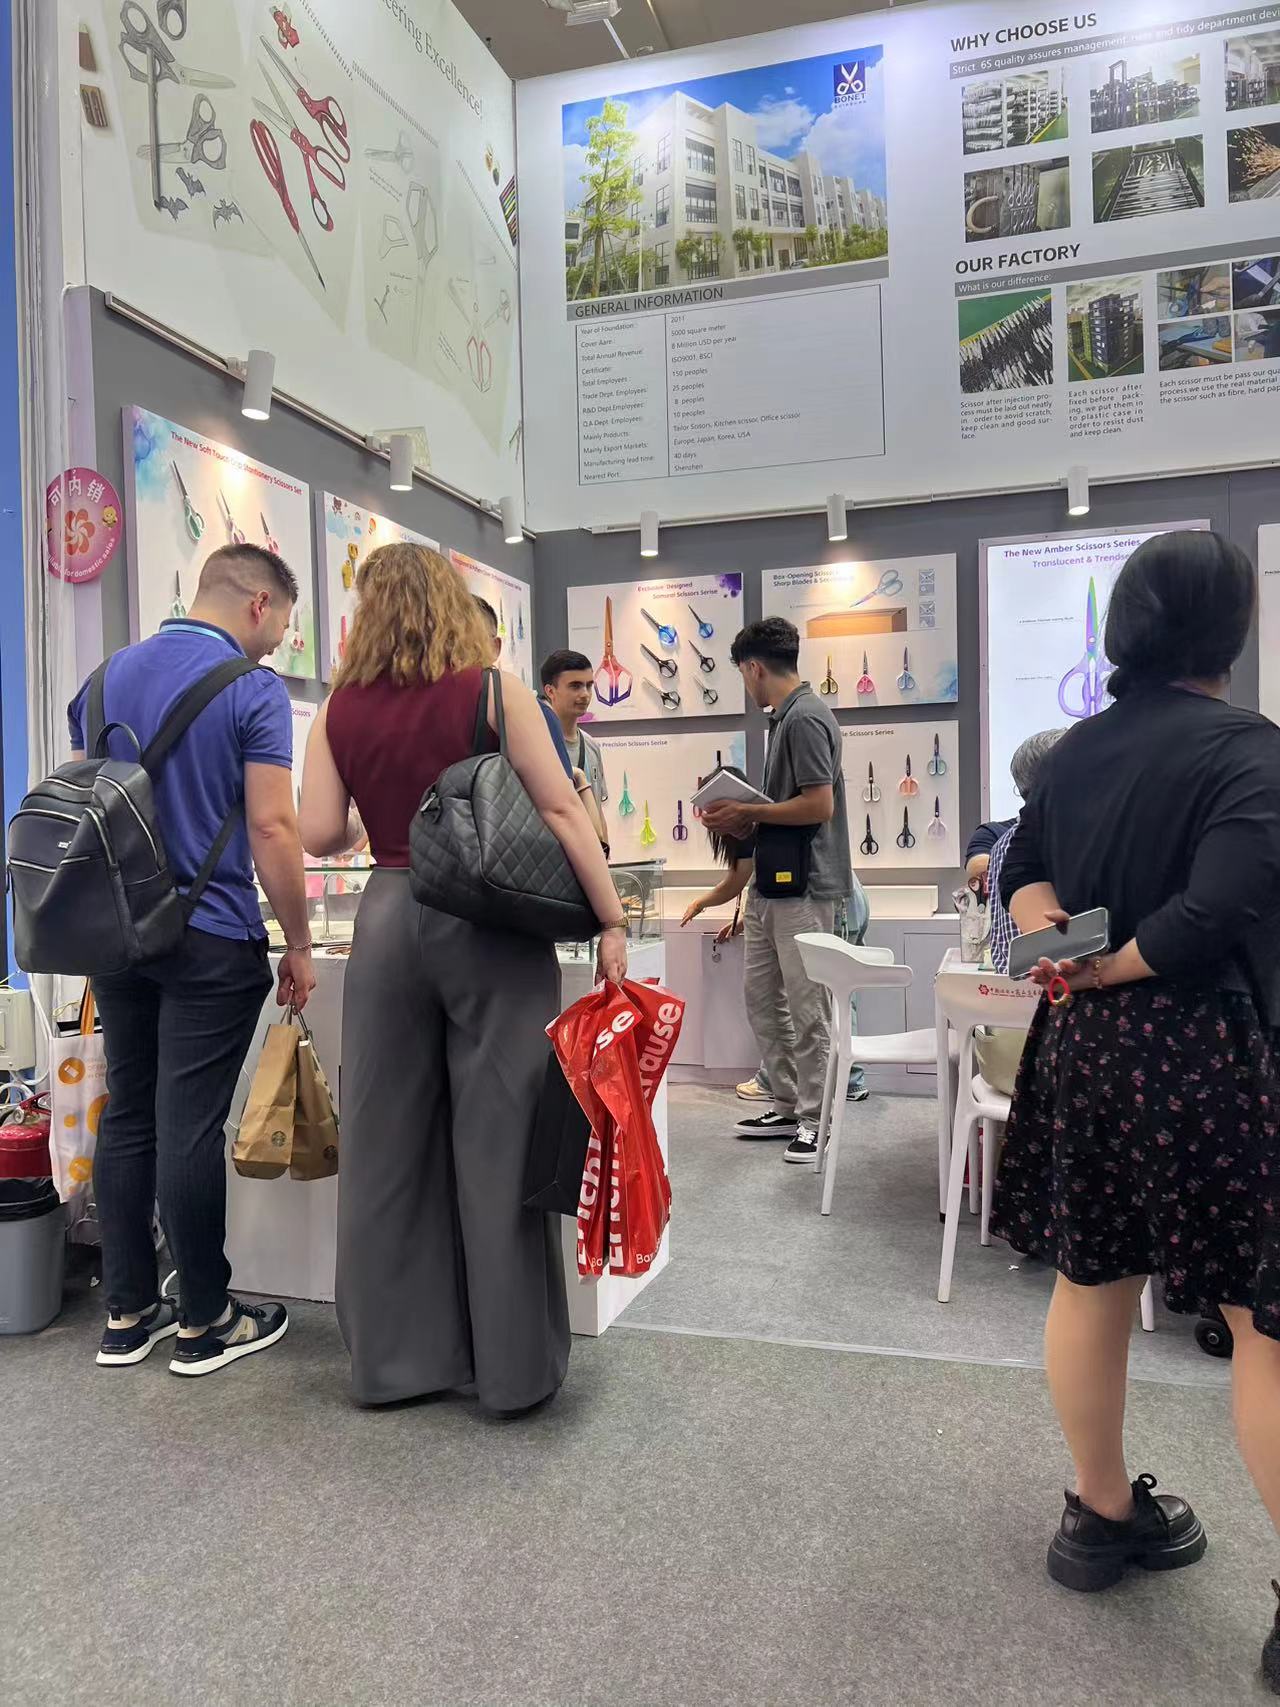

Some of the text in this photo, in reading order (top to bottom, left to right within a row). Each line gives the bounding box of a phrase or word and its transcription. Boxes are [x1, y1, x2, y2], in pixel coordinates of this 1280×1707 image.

[950, 13, 1097, 52] WHY CHOOSE US
[952, 62, 976, 75] Strict
[994, 54, 1026, 68] quality
[1027, 48, 1062, 61] assures
[1176, 23, 1196, 36] tidy
[1197, 12, 1257, 31] department
[955, 243, 1081, 275] OUR FACTORY
[958, 283, 981, 293] What
[982, 281, 990, 290] is
[991, 279, 1006, 289] our
[575, 287, 724, 318] GENERAL INFORMATION
[687, 327, 707, 336] square
[708, 324, 727, 332] meter
[698, 338, 712, 346] USD
[724, 336, 737, 344] year
[582, 354, 596, 362] Total
[596, 351, 617, 359] Annual
[699, 352, 713, 360] BSCI
[582, 379, 596, 387] Total
[1159, 380, 1177, 388] Each
[1177, 377, 1201, 385] scissor
[1203, 374, 1222, 382] must
[1234, 371, 1251, 379] pass
[1246, 377, 1278, 385] material
[582, 392, 598, 400] Trade
[1068, 384, 1143, 398] Each scissor after
[960, 394, 1035, 409] Scissor after injection
[1068, 398, 1087, 406] fixed
[1089, 395, 1115, 404] before
[1160, 396, 1172, 404] the
[1173, 394, 1198, 402] scissor
[1199, 391, 1217, 399] such
[582, 406, 597, 414] R&D
[960, 409, 975, 417] cess
[993, 405, 1003, 413] be
[1004, 404, 1017, 412] laid
[1031, 400, 1053, 410] neatly
[1098, 402, 1112, 411] put
[1113, 401, 1134, 409] them
[973, 414, 993, 423] order
[1080, 412, 1110, 421] plastic
[1112, 409, 1132, 417] case
[673, 424, 690, 432] Tailor
[713, 419, 737, 427] Kitchen
[780, 412, 801, 420] scissor
[979, 421, 999, 431] clean
[1000, 420, 1015, 428] and
[1016, 418, 1036, 428] good
[1069, 421, 1091, 430] order
[1102, 417, 1125, 427] resist
[1126, 416, 1144, 424] dust
[583, 433, 603, 441] Mainly
[1069, 428, 1102, 438] and keep
[171, 430, 183, 443] The
[183, 436, 198, 449] New
[603, 444, 623, 453] Export
[682, 452, 697, 460] days
[583, 458, 626, 467] Manufacturing
[674, 463, 704, 472] Shenzhen
[584, 473, 606, 481] Nearest
[1003, 539, 1141, 558] The New Amber Scissors Series
[1032, 555, 1093, 568] Translucent &
[666, 581, 693, 590] Designed
[676, 590, 699, 598] Scissors
[601, 741, 628, 749] Precision
